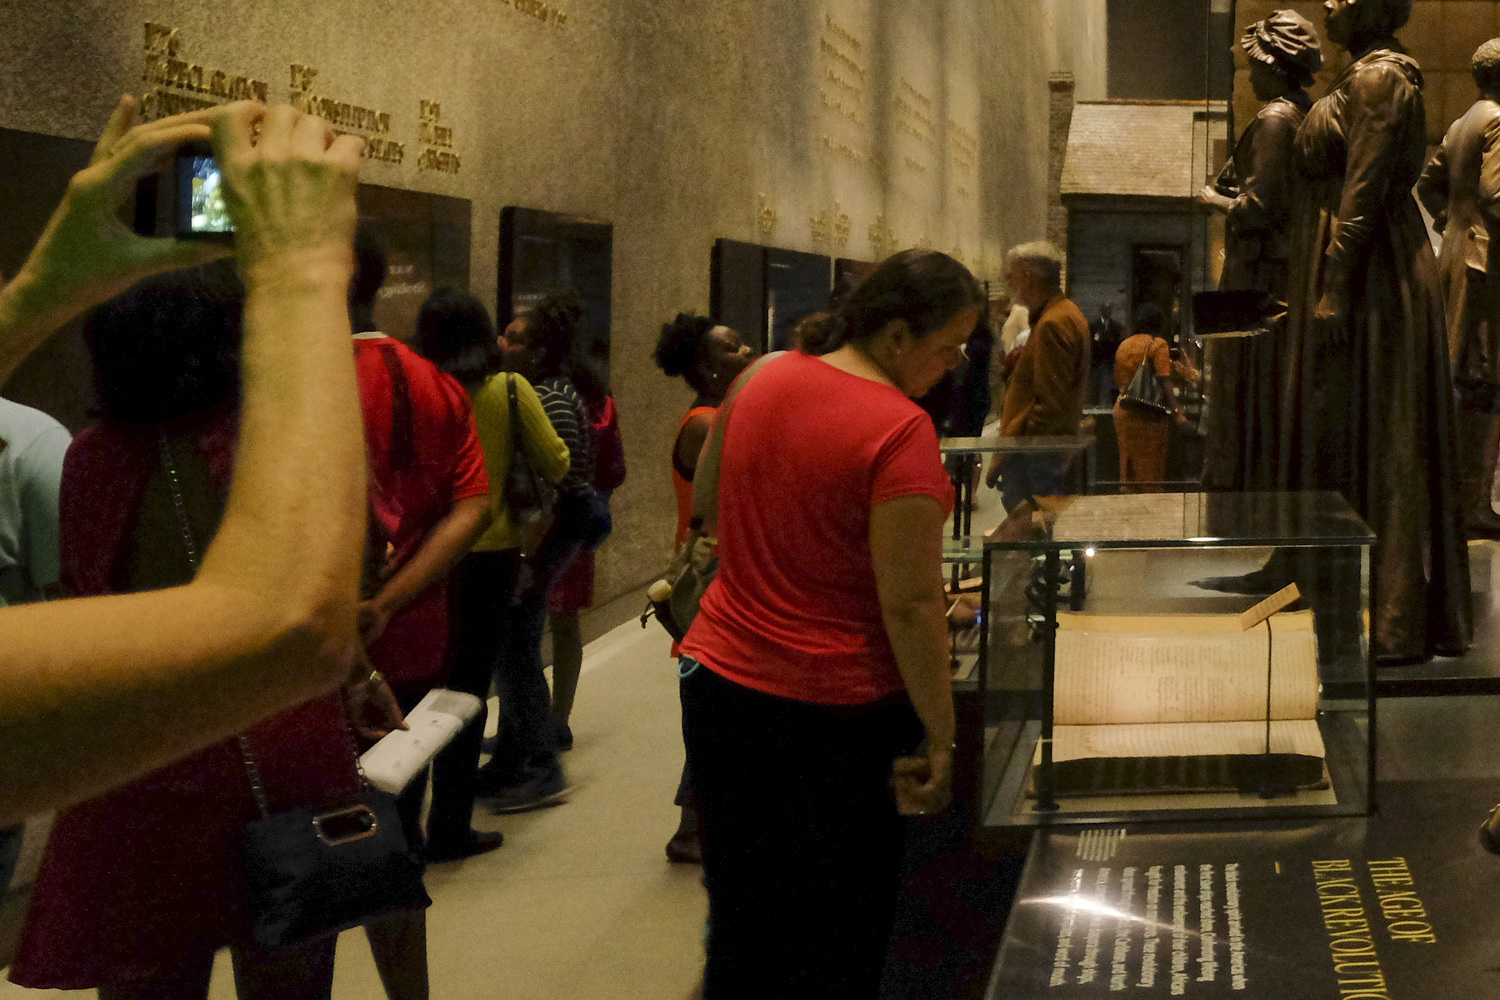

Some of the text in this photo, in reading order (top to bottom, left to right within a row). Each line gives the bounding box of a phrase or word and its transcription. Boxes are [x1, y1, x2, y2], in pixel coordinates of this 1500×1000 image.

[1311, 859, 1362, 906] BLACK
[1367, 857, 1437, 944] THE AGE OF
